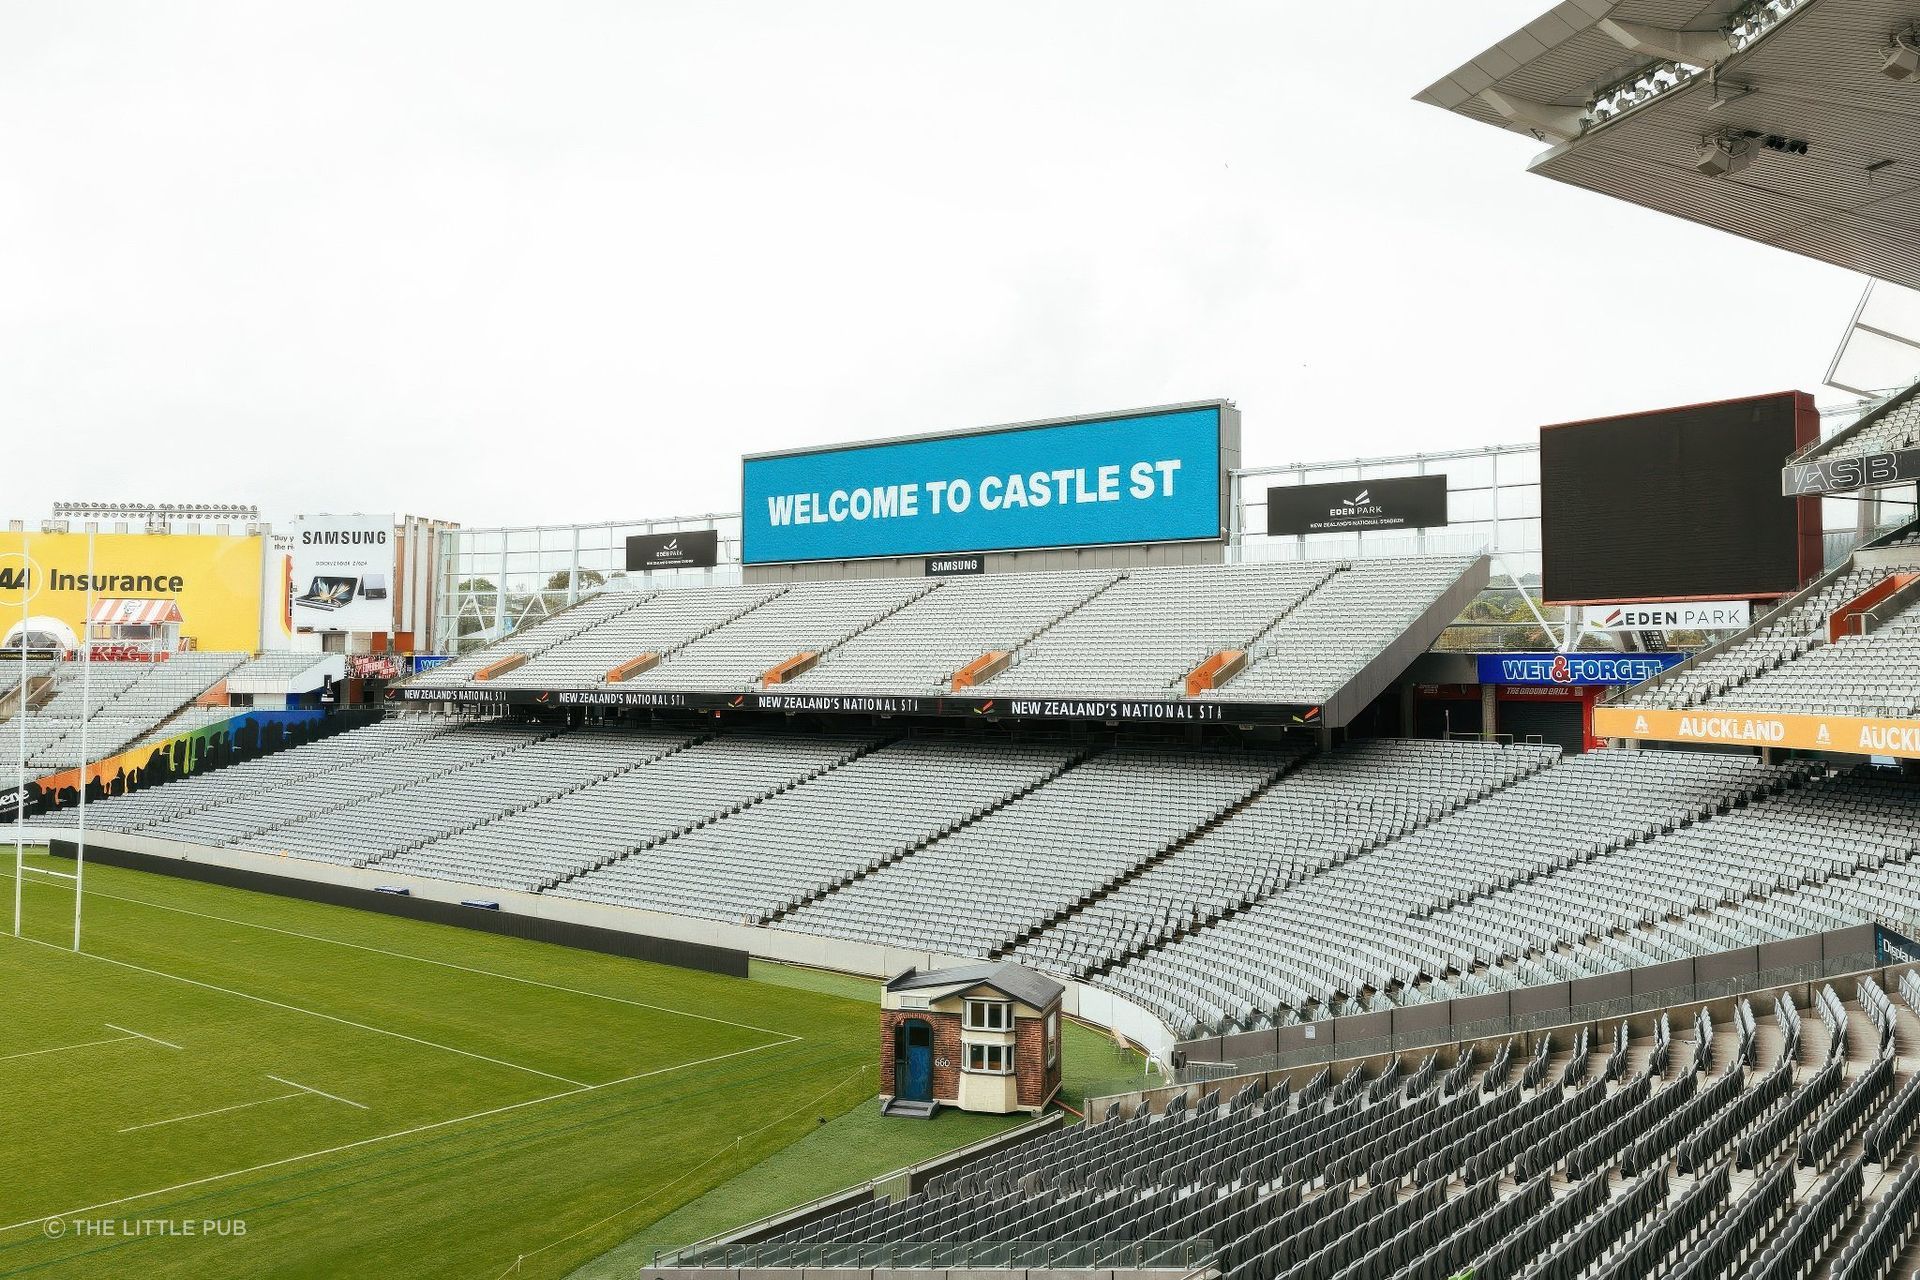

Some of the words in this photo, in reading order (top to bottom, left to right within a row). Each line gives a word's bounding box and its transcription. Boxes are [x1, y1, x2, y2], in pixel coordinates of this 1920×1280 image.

[1797, 452, 1898, 493] ASB
[768, 484, 918, 526] WELCOME
[926, 478, 972, 514] TO
[979, 465, 1120, 511] CASTLE
[1130, 459, 1181, 499] ST
[1330, 508, 1355, 516] EDEN
[1357, 506, 1382, 514] PARK
[302, 531, 386, 544] SAMSUNG
[931, 559, 978, 572] SAMSUNG
[50, 569, 183, 592] Insurance
[1626, 612, 1677, 625] EDEN
[1685, 609, 1740, 625] PARK
[91, 646, 140, 661] KFC
[404, 689, 420, 699] NEW
[421, 690, 457, 700] ZEALAND'S
[459, 690, 493, 701] NATIONAL
[559, 692, 579, 703] NEW
[579, 693, 624, 704] ZEALAND'S
[625, 694, 668, 705] NATIONAL
[758, 697, 781, 708] NEW
[784, 697, 840, 710] ZEALAND'S
[843, 698, 897, 711] NATIONAL
[1011, 701, 1041, 715] NEW
[1044, 702, 1117, 717] ZEALAND'S
[1122, 704, 1193, 718] NATIONAL
[1199, 705, 1222, 719] STA
[1678, 717, 1785, 742] AUCKLAND
[0, 790, 30, 806] ene
[935, 1058, 950, 1067] 660
